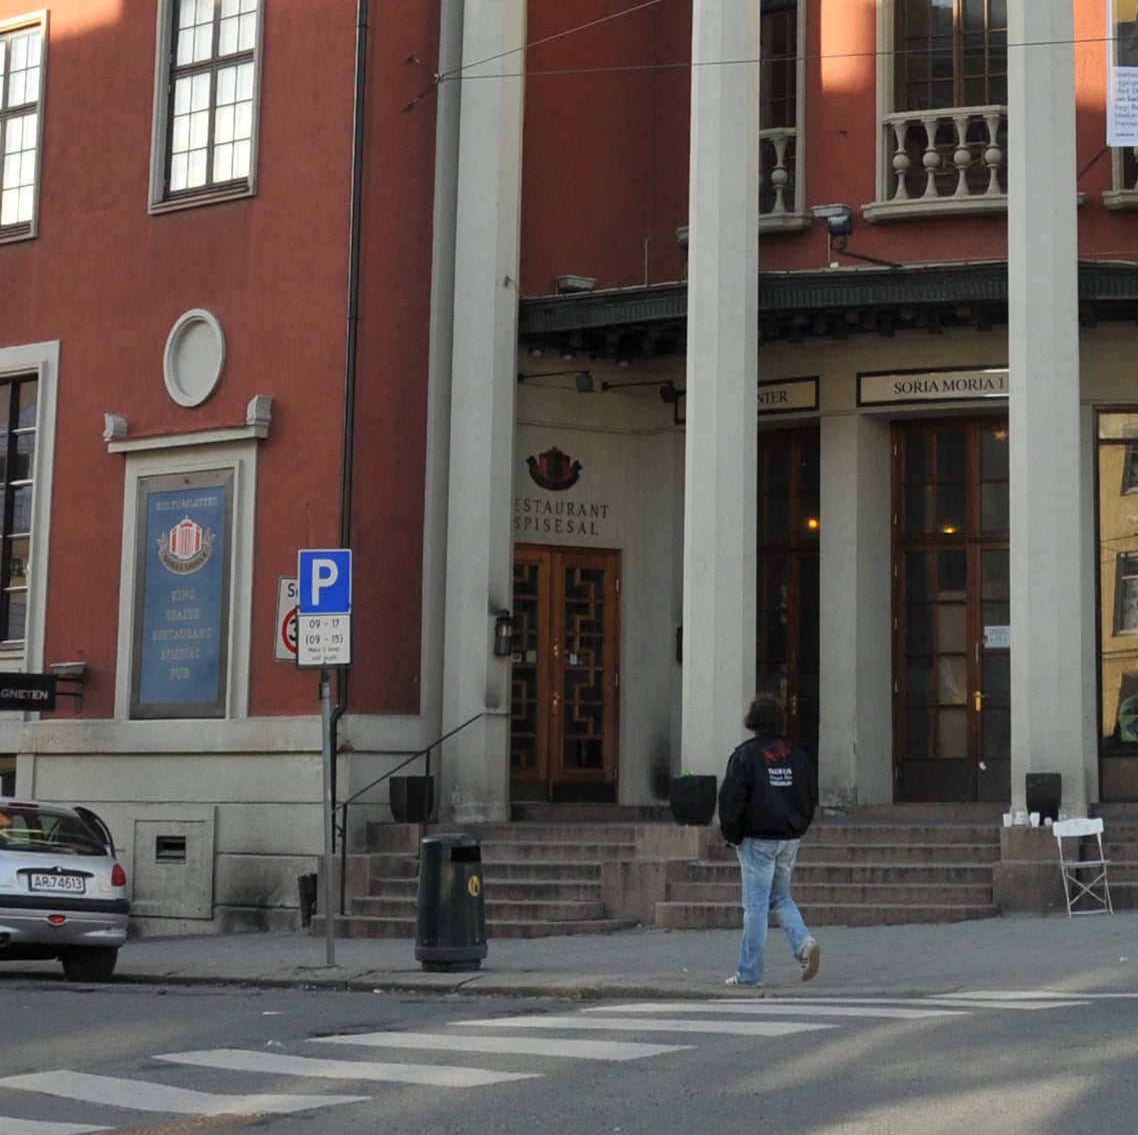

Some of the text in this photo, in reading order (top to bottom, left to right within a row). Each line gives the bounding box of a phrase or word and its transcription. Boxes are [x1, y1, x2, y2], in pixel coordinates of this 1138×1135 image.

[893, 380, 940, 395] SORIA
[942, 377, 995, 392] MORIA
[757, 390, 789, 404] NTER
[514, 497, 609, 519] ESTAURANT
[311, 558, 339, 606] P
[309, 619, 321, 629] 09
[332, 618, 340, 628] 17
[305, 634, 321, 645] (09
[332, 633, 344, 644] 15)
[0, 689, 49, 700] GNETEN
